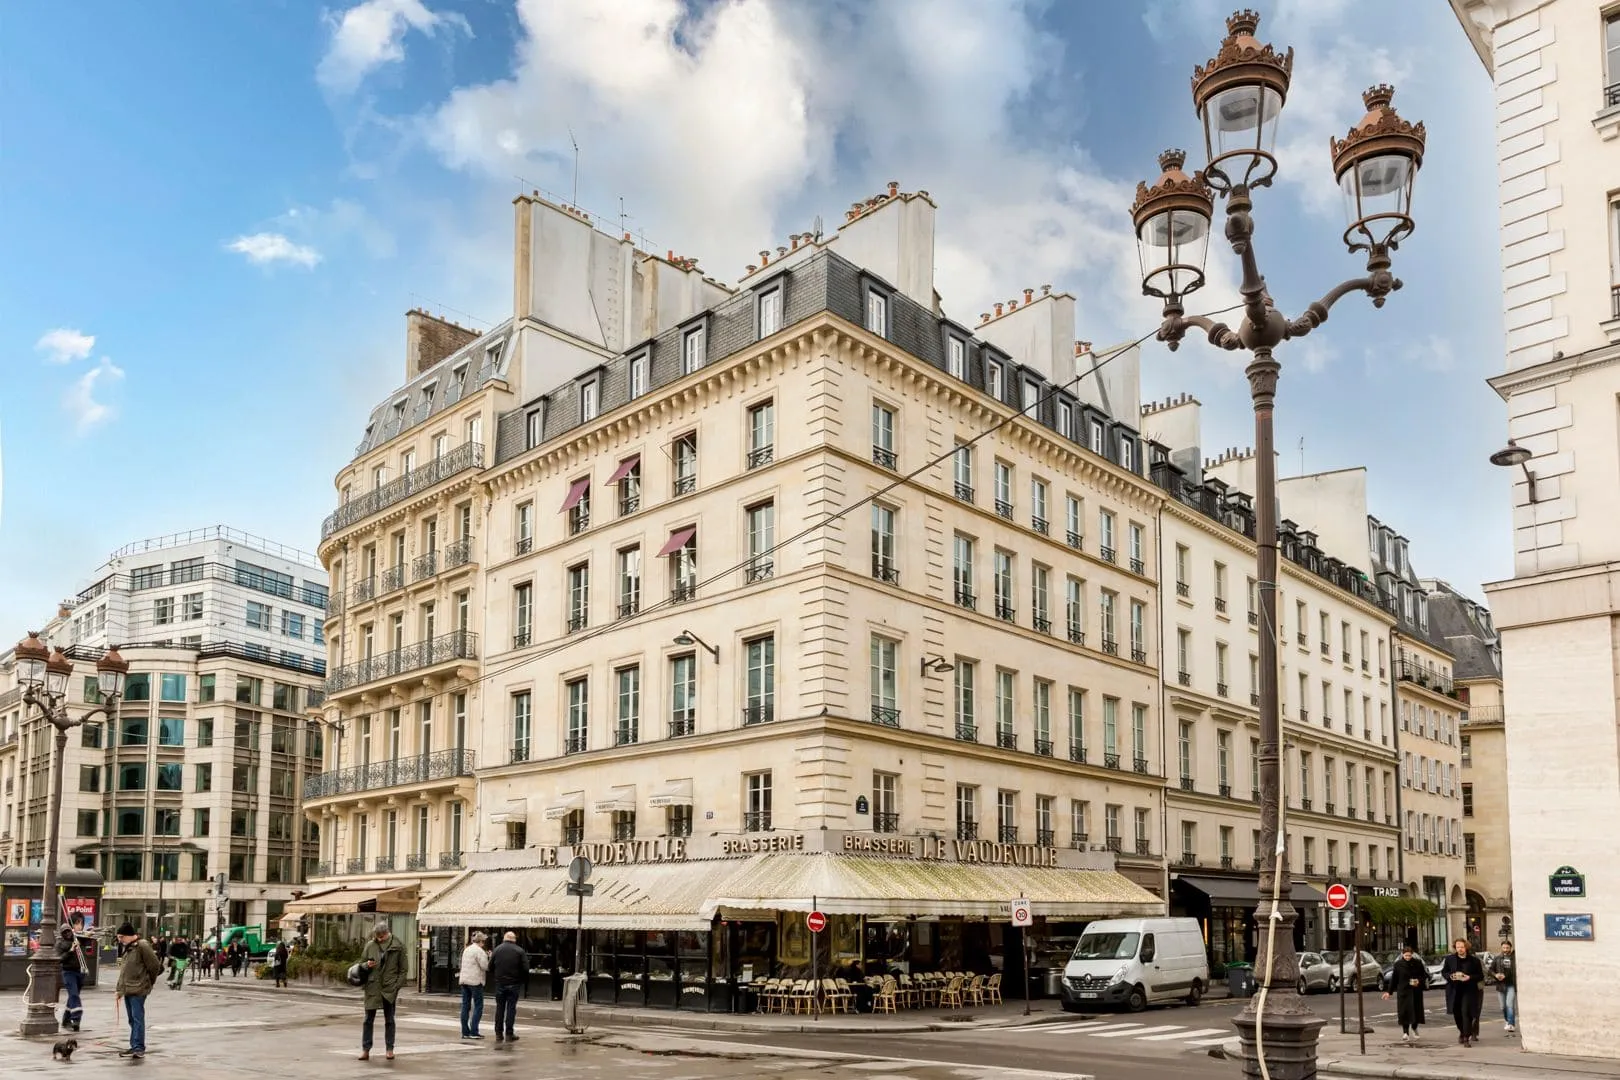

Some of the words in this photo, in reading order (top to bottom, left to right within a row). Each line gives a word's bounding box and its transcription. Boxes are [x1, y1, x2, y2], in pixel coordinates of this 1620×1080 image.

[538, 847, 558, 866] LE
[570, 837, 687, 864] VAUDEVILLE
[723, 835, 804, 854] BRASSERIE
[844, 835, 915, 854] BRASSERIE
[921, 837, 946, 860] LE
[953, 840, 1057, 866] VAUDEVILLE
[75, 905, 93, 913] Point
